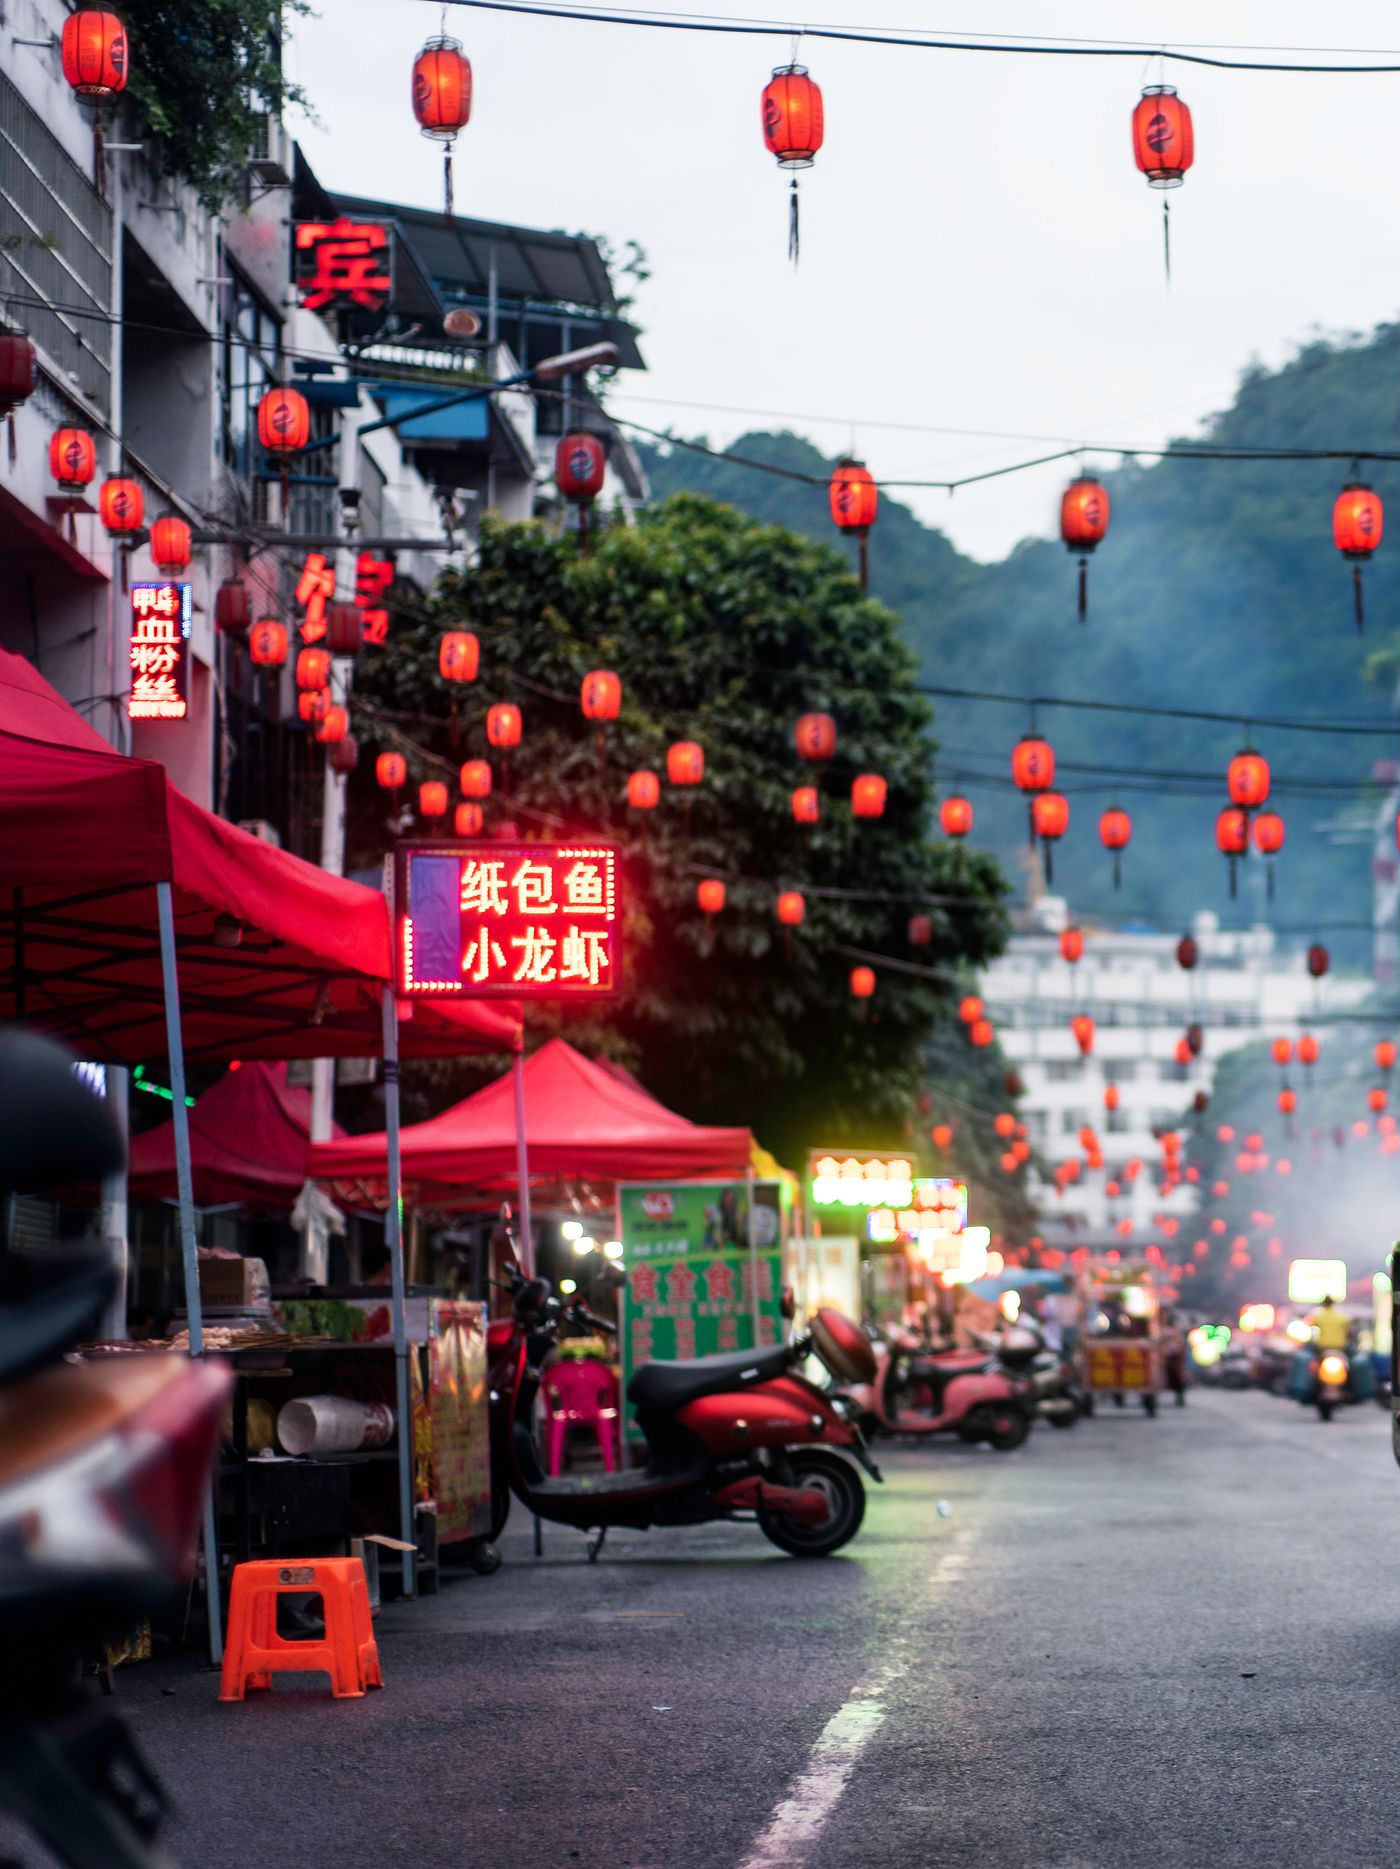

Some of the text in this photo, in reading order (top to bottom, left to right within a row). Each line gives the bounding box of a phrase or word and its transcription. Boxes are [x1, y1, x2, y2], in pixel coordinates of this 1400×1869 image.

[130, 587, 181, 700] 鸭血粉丝
[460, 859, 606, 915] 纸包鱼
[461, 925, 609, 985] 小龙虾
